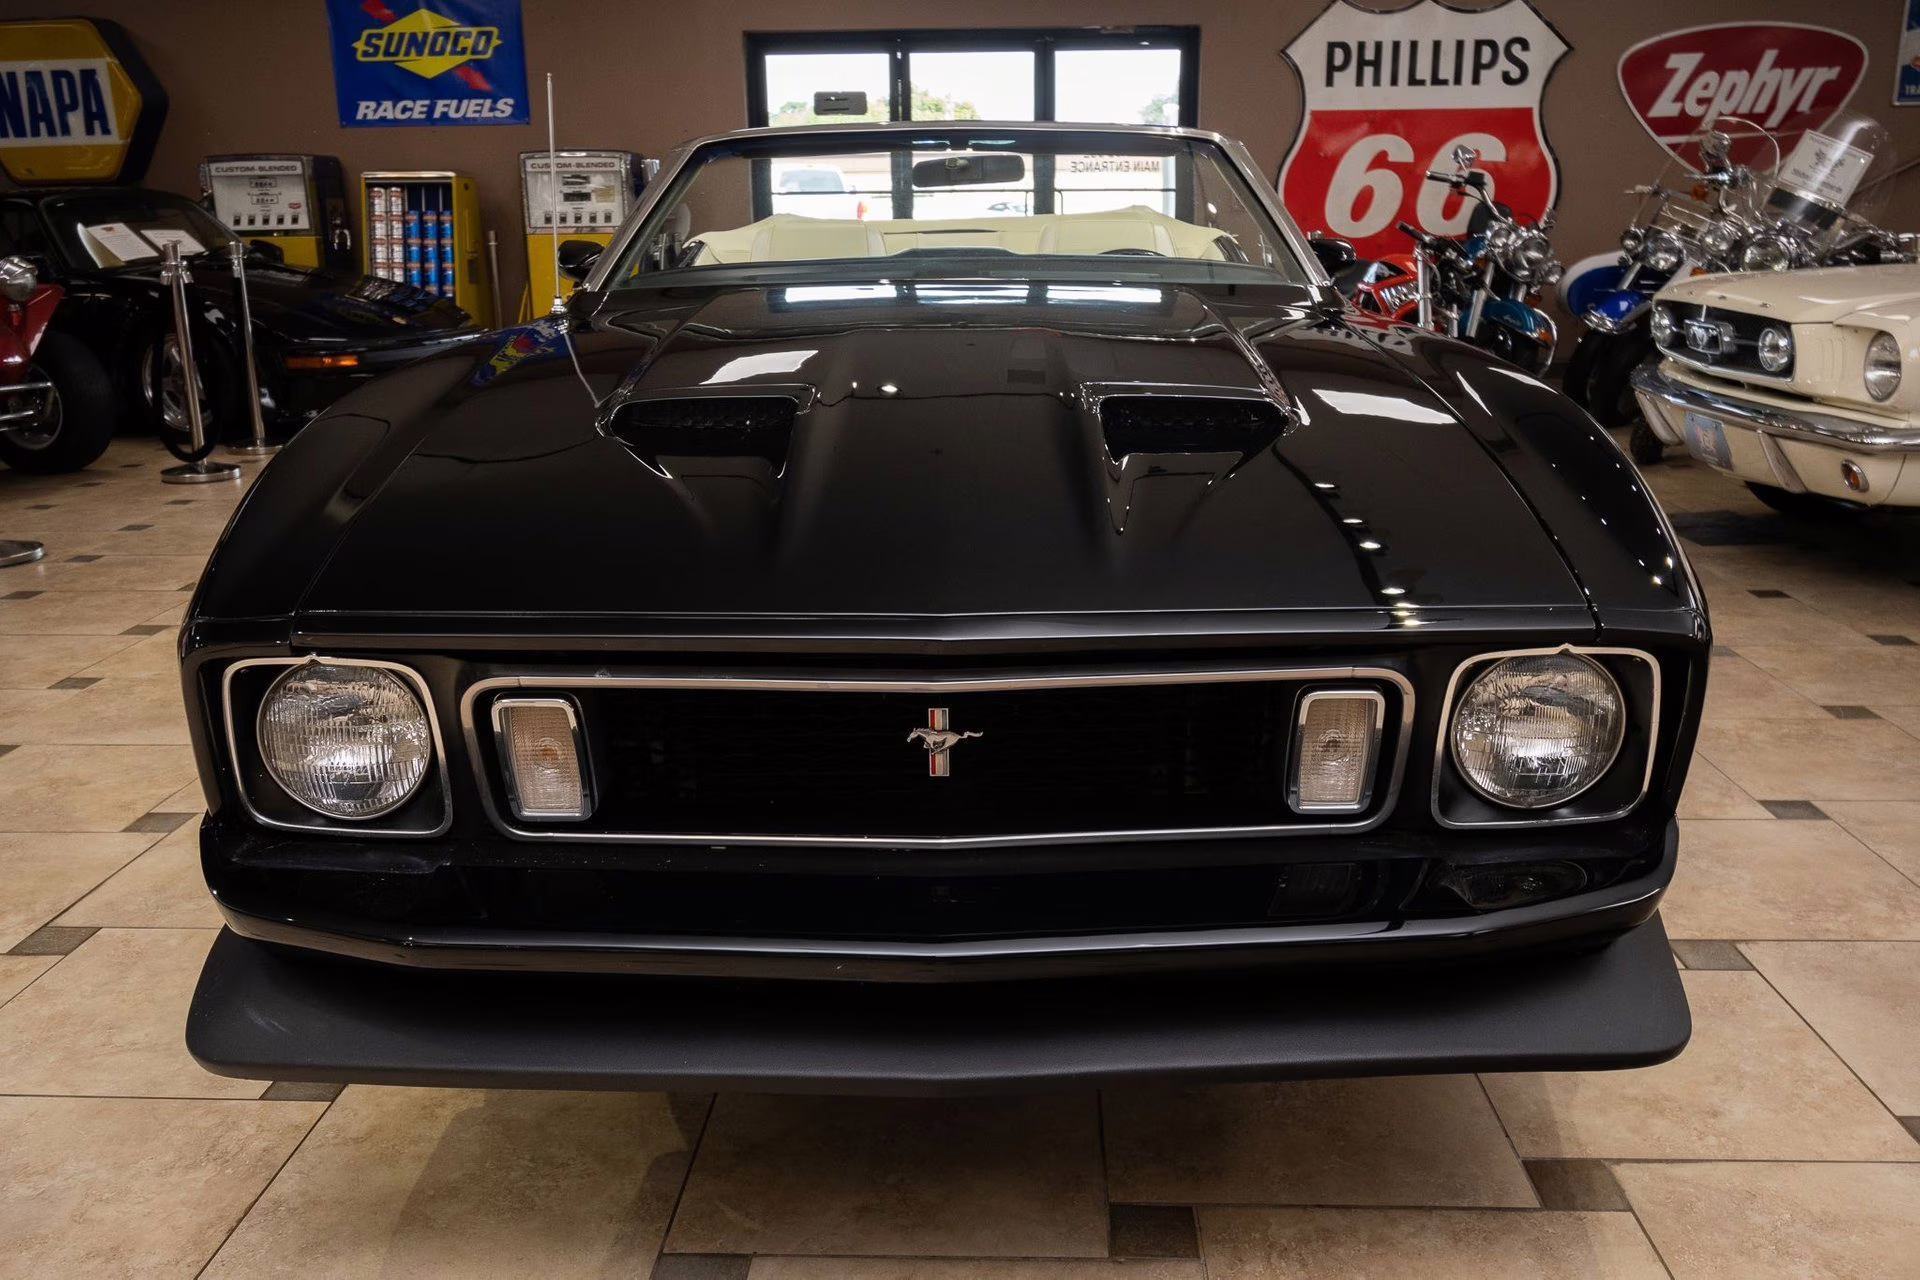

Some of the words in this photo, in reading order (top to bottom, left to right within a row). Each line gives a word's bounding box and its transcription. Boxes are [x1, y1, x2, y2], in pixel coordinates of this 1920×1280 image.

[361, 31, 495, 58] SUNOCO
[1325, 37, 1531, 87] PHILLIPS
[0, 68, 112, 138] NAPA
[356, 100, 430, 120] RACE
[433, 98, 514, 119] FUELS
[1647, 48, 1842, 130] Zephyr
[1324, 132, 1507, 238] 66
